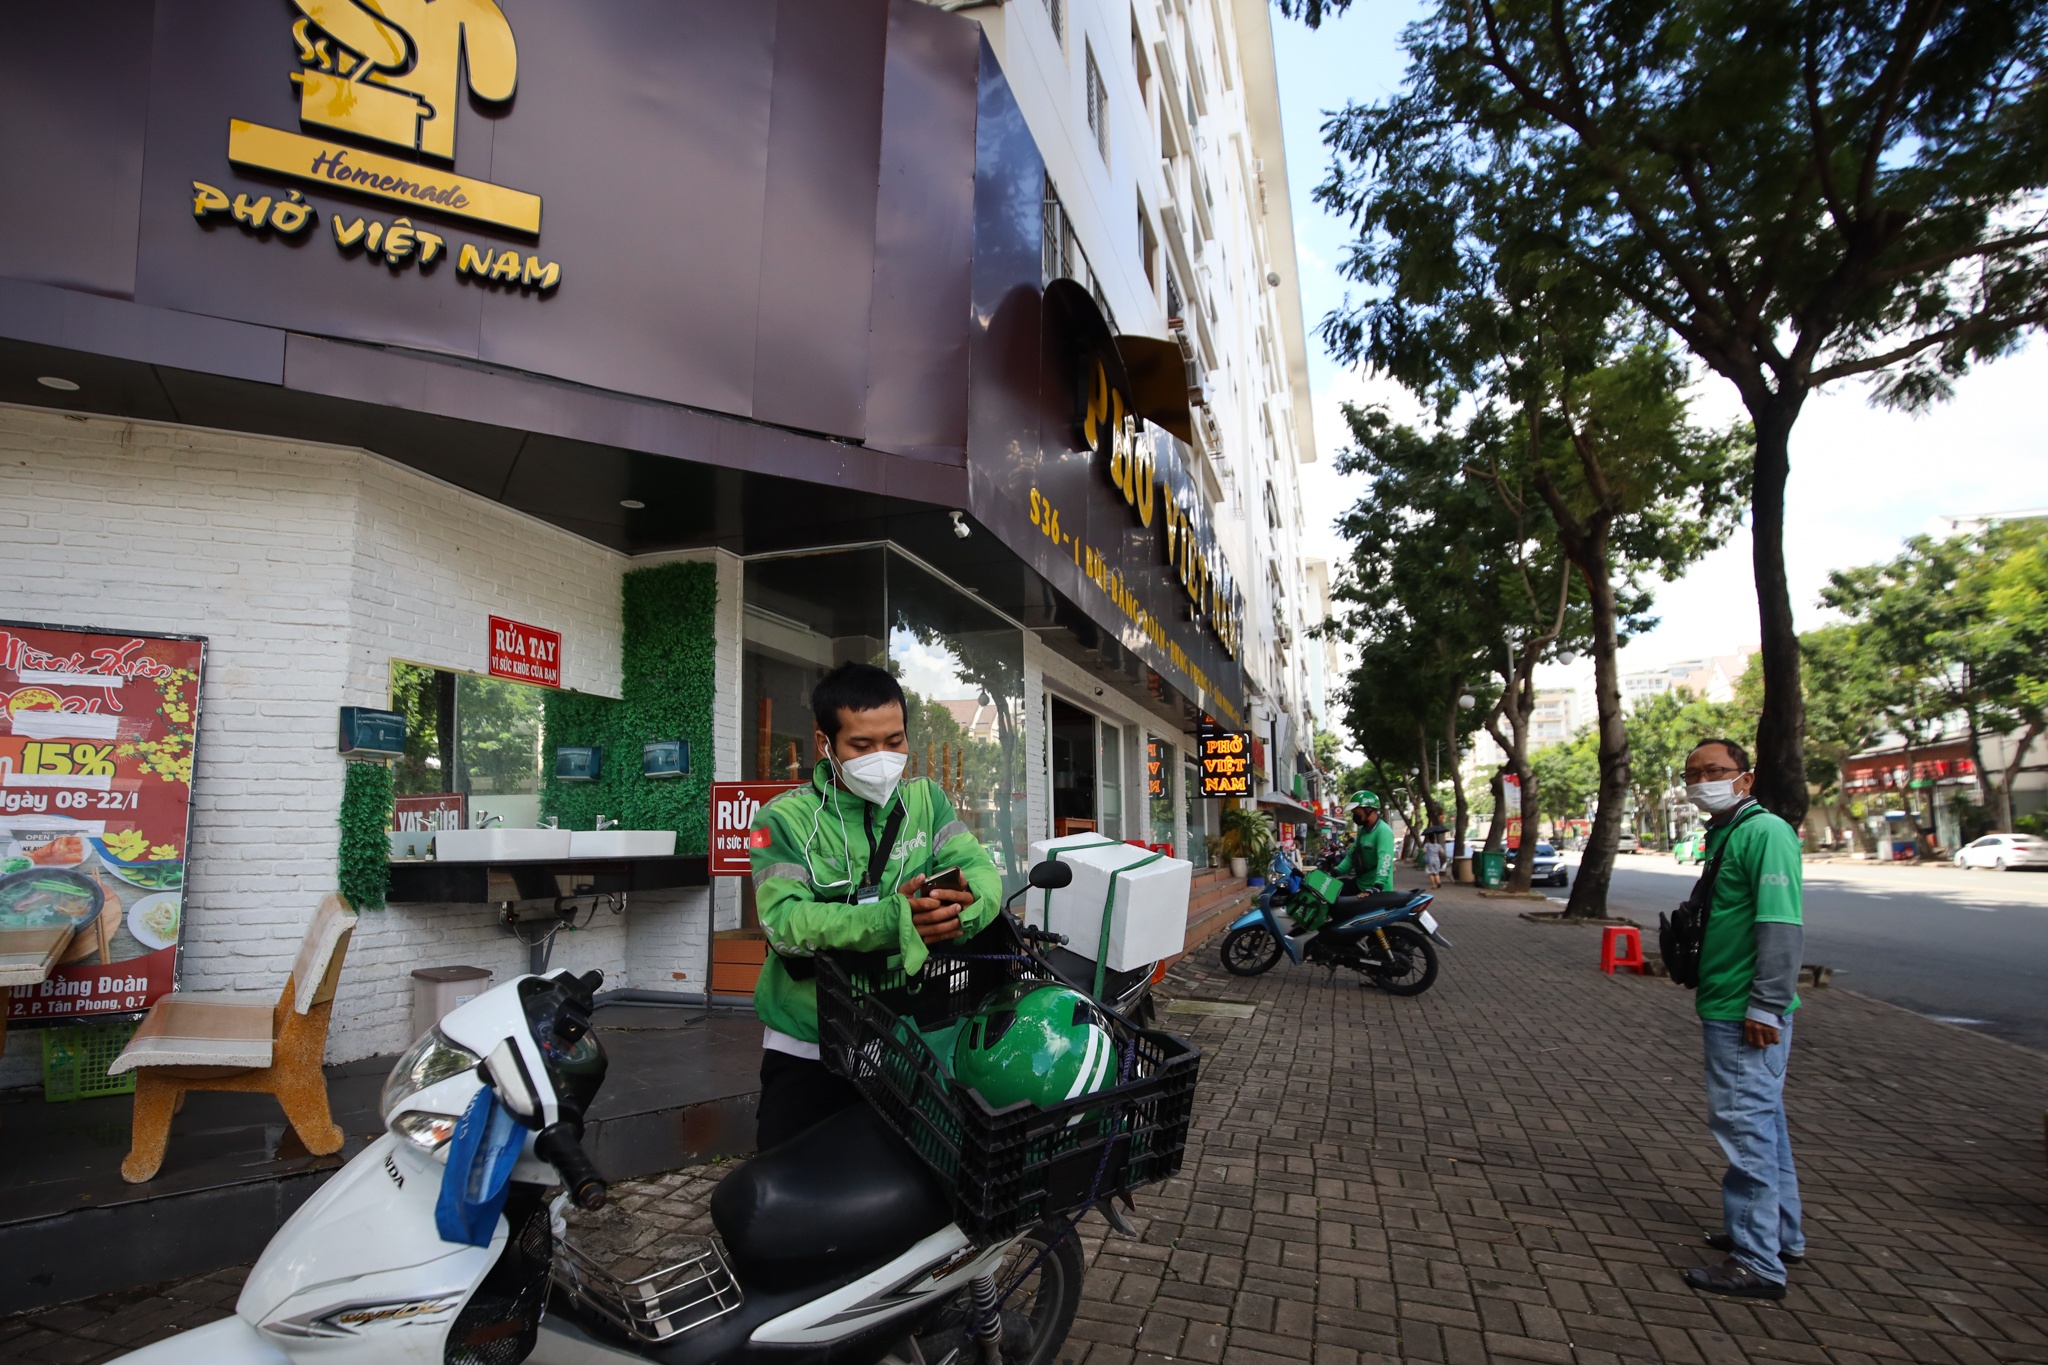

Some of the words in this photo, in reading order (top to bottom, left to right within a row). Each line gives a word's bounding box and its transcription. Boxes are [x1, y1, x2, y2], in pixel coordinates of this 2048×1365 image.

[311, 150, 470, 209] Homemade
[192, 180, 313, 232] PHỞ
[333, 214, 444, 263] VIỆT
[458, 243, 561, 289] NAM
[1030, 487, 1060, 545] S36
[495, 623, 525, 655] RỬA
[529, 637, 556, 662] TAY
[492, 653, 499, 670] VÌ
[499, 656, 512, 672] SỨC
[531, 661, 543, 679] CỦA
[544, 667, 556, 683] BẠN
[1206, 735, 1242, 754] PHỞ
[20, 741, 116, 778] 15%
[1204, 755, 1246, 775] VIỆT
[1205, 777, 1246, 791] NAM
[55, 790, 138, 811] 08-22/1
[717, 835, 725, 850] VÌ
[726, 834, 742, 850] SỨC
[889, 828, 927, 860] Grab
[1760, 870, 1789, 887] rab
[40, 975, 92, 997] Bằng
[97, 974, 148, 994] Đoàn
[31, 1002, 42, 1014] P.
[48, 1000, 72, 1013] Tân
[75, 998, 121, 1012] Phong,
[125, 995, 147, 1009] Q.7
[384, 1150, 405, 1190] NDA
